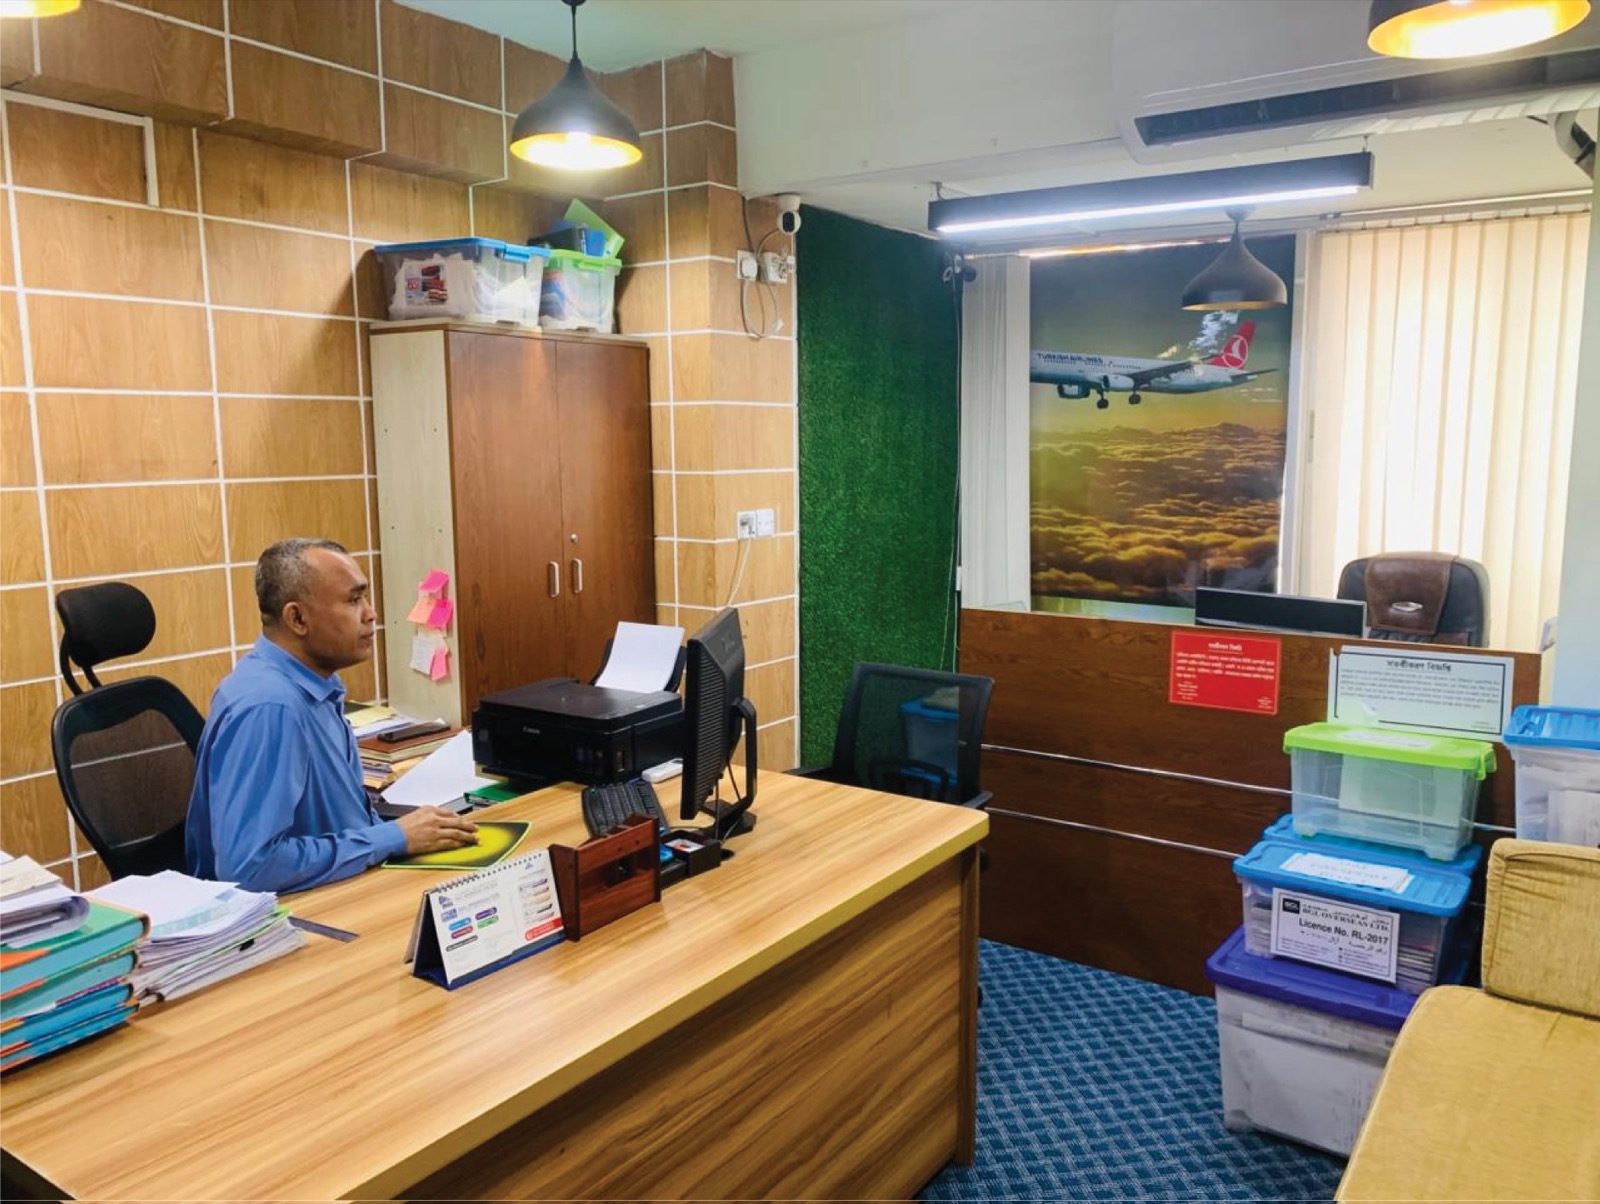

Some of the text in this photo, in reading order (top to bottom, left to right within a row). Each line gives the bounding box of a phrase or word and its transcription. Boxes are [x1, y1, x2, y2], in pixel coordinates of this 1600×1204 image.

[1299, 918, 1332, 934] Licence
[1334, 926, 1349, 937] No.
[1352, 930, 1388, 945] RL-2017
